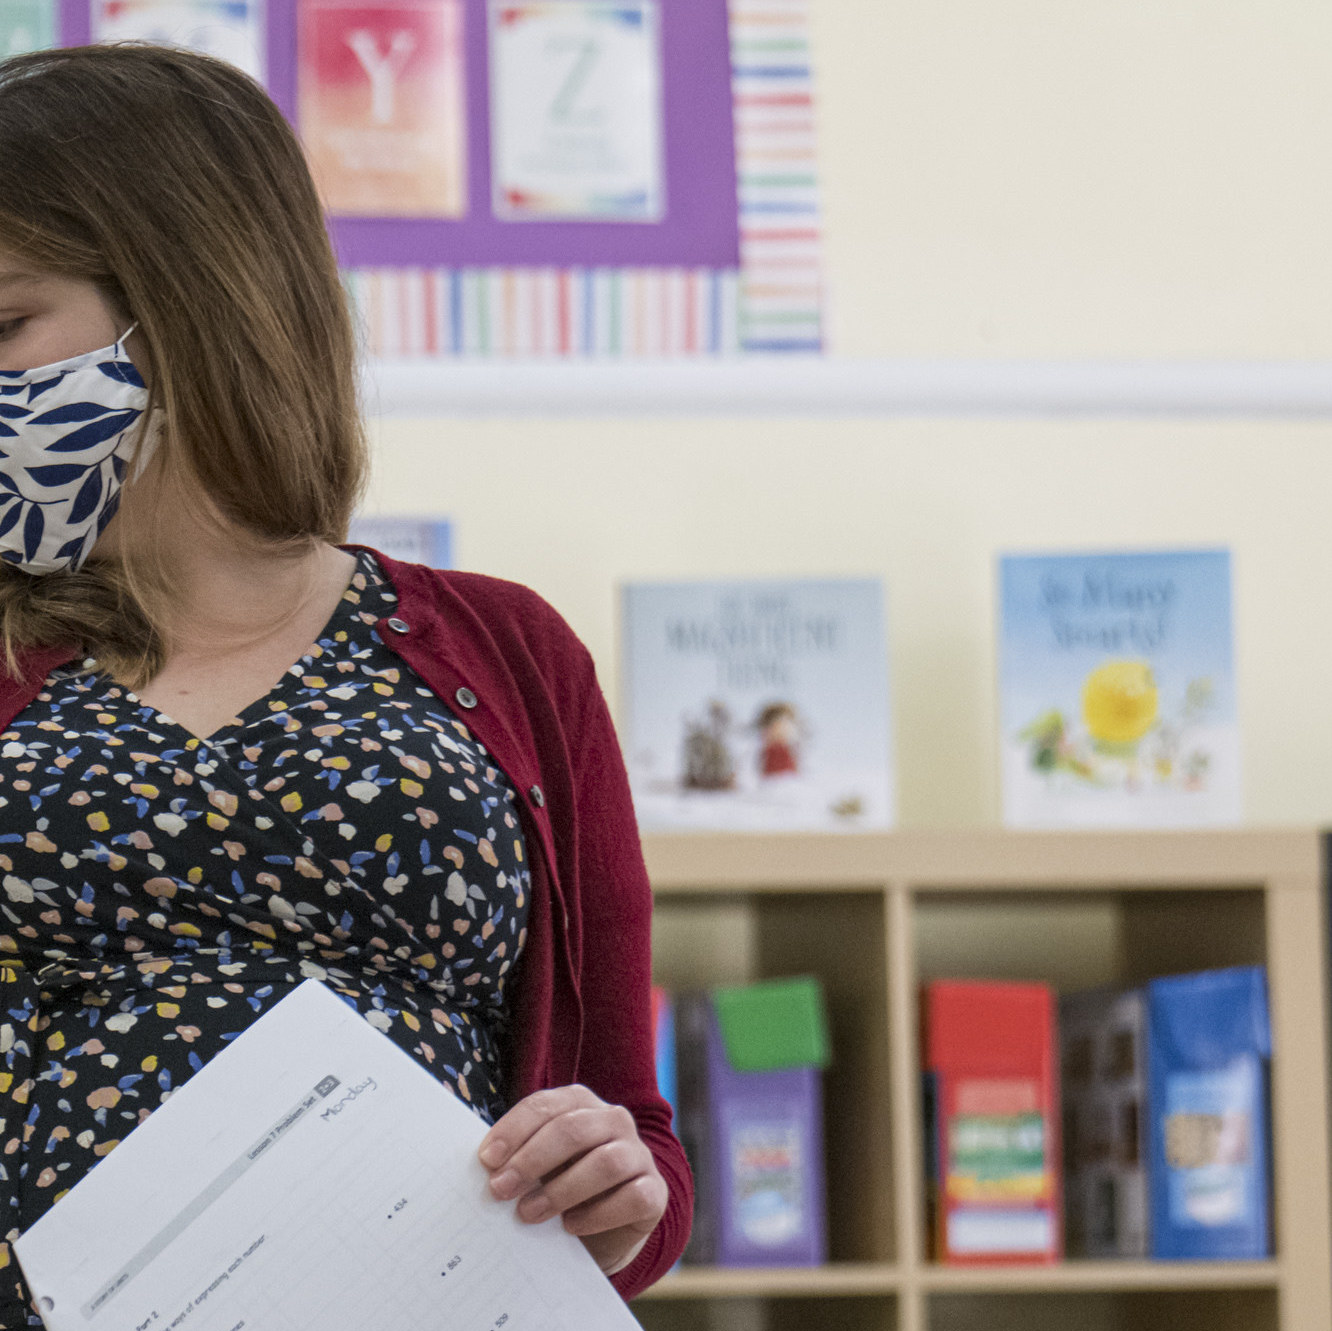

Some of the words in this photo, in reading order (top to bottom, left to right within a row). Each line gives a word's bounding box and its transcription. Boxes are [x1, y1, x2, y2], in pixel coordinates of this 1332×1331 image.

[347, 28, 416, 125] Y
[544, 36, 604, 125] Z
[319, 1077, 378, 1122] Monday
[247, 1138, 272, 1160] Lesson
[269, 1131, 276, 1139] 7
[275, 1107, 305, 1134] Problem
[302, 1096, 317, 1109] Set
[394, 1198, 408, 1212] 434
[446, 1255, 462, 1270] 863
[495, 1313, 509, 1328] 509
